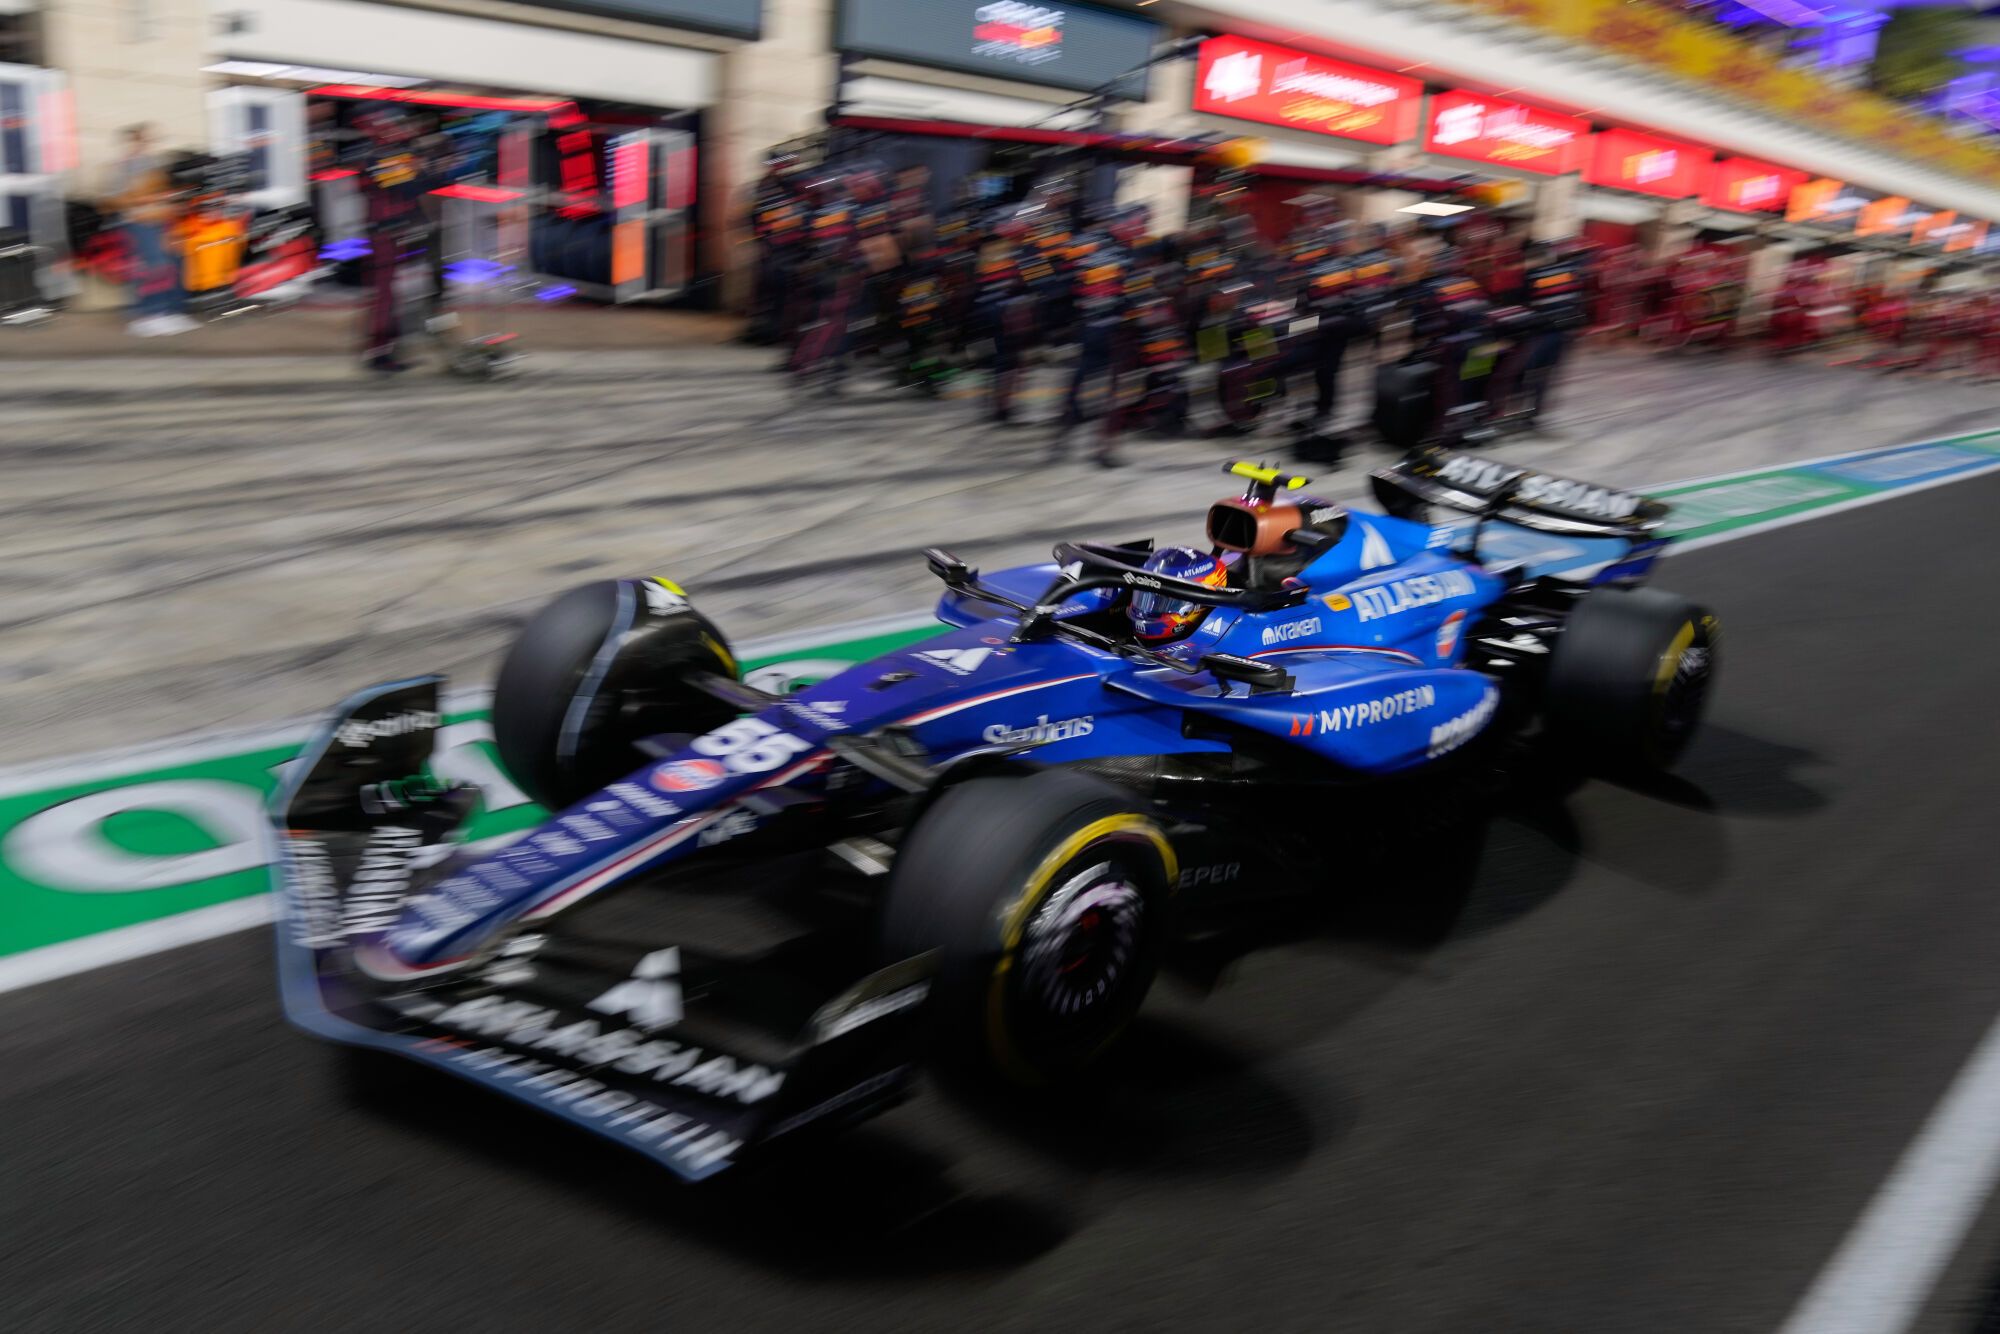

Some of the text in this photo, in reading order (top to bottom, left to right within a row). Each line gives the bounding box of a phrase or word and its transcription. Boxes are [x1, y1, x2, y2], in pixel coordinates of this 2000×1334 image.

[1435, 455, 1641, 519] ATLSSIAN
[1350, 569, 1477, 623] ATLASSIAN
[982, 714, 1095, 744] Stephens
[1320, 685, 1436, 735] MYPROTEIN
[1177, 862, 1241, 890] EPER
